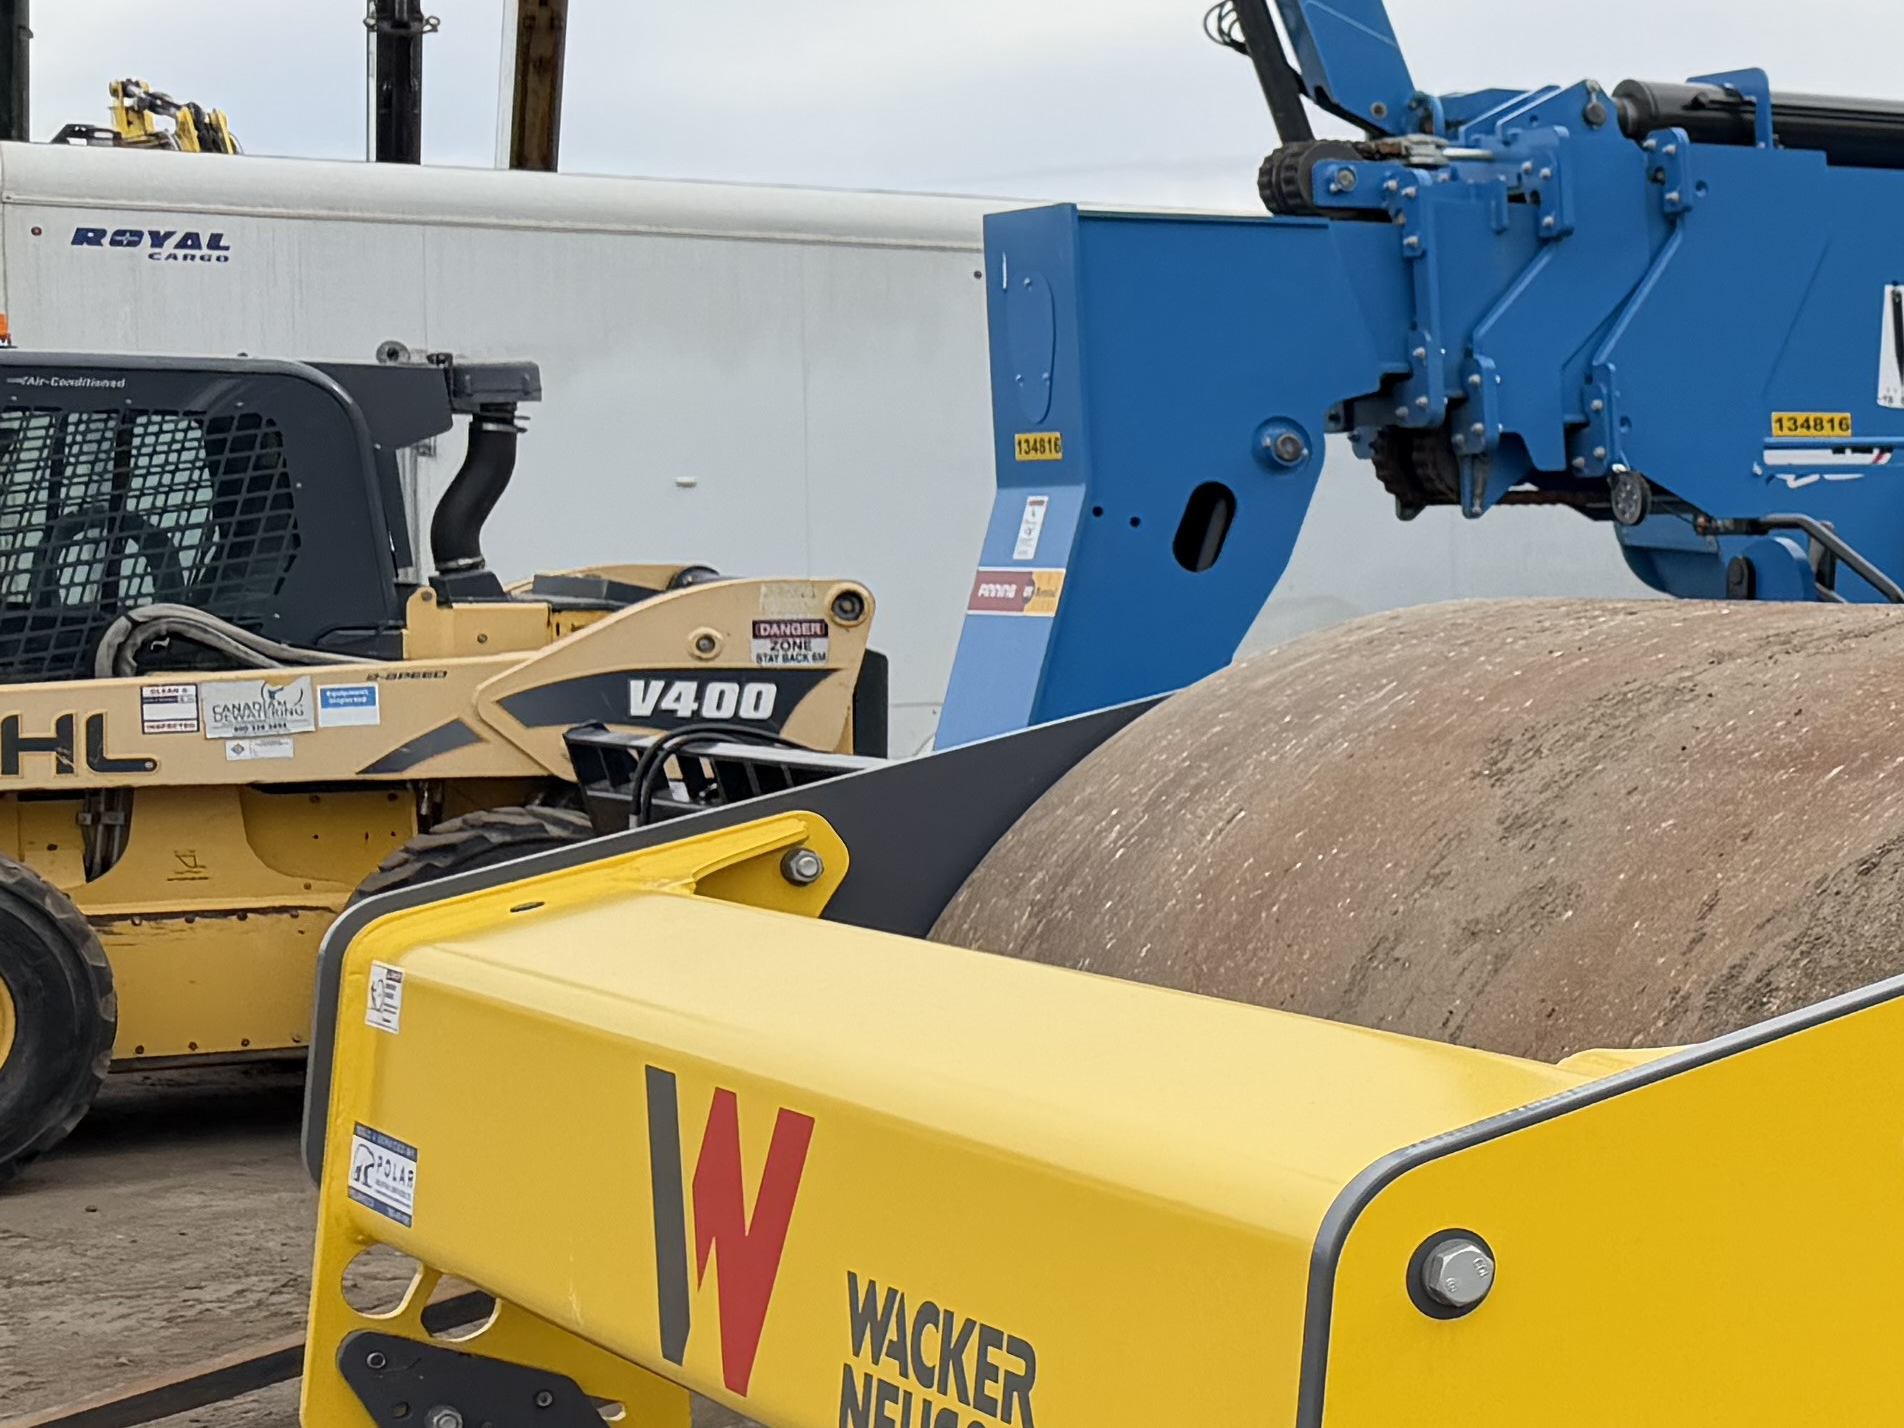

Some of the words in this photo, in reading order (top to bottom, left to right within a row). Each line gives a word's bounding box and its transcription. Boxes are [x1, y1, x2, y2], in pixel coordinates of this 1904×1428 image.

[71, 227, 231, 251] ROYAL
[148, 252, 230, 263] CARGO
[1774, 417, 1850, 433] 134816
[1017, 438, 1061, 455] 134816
[759, 622, 822, 635] DANGER
[770, 639, 812, 652] ZONE
[756, 653, 780, 664] STAY
[782, 652, 810, 663] BACK
[629, 679, 777, 720] V400
[1, 713, 157, 775] HL
